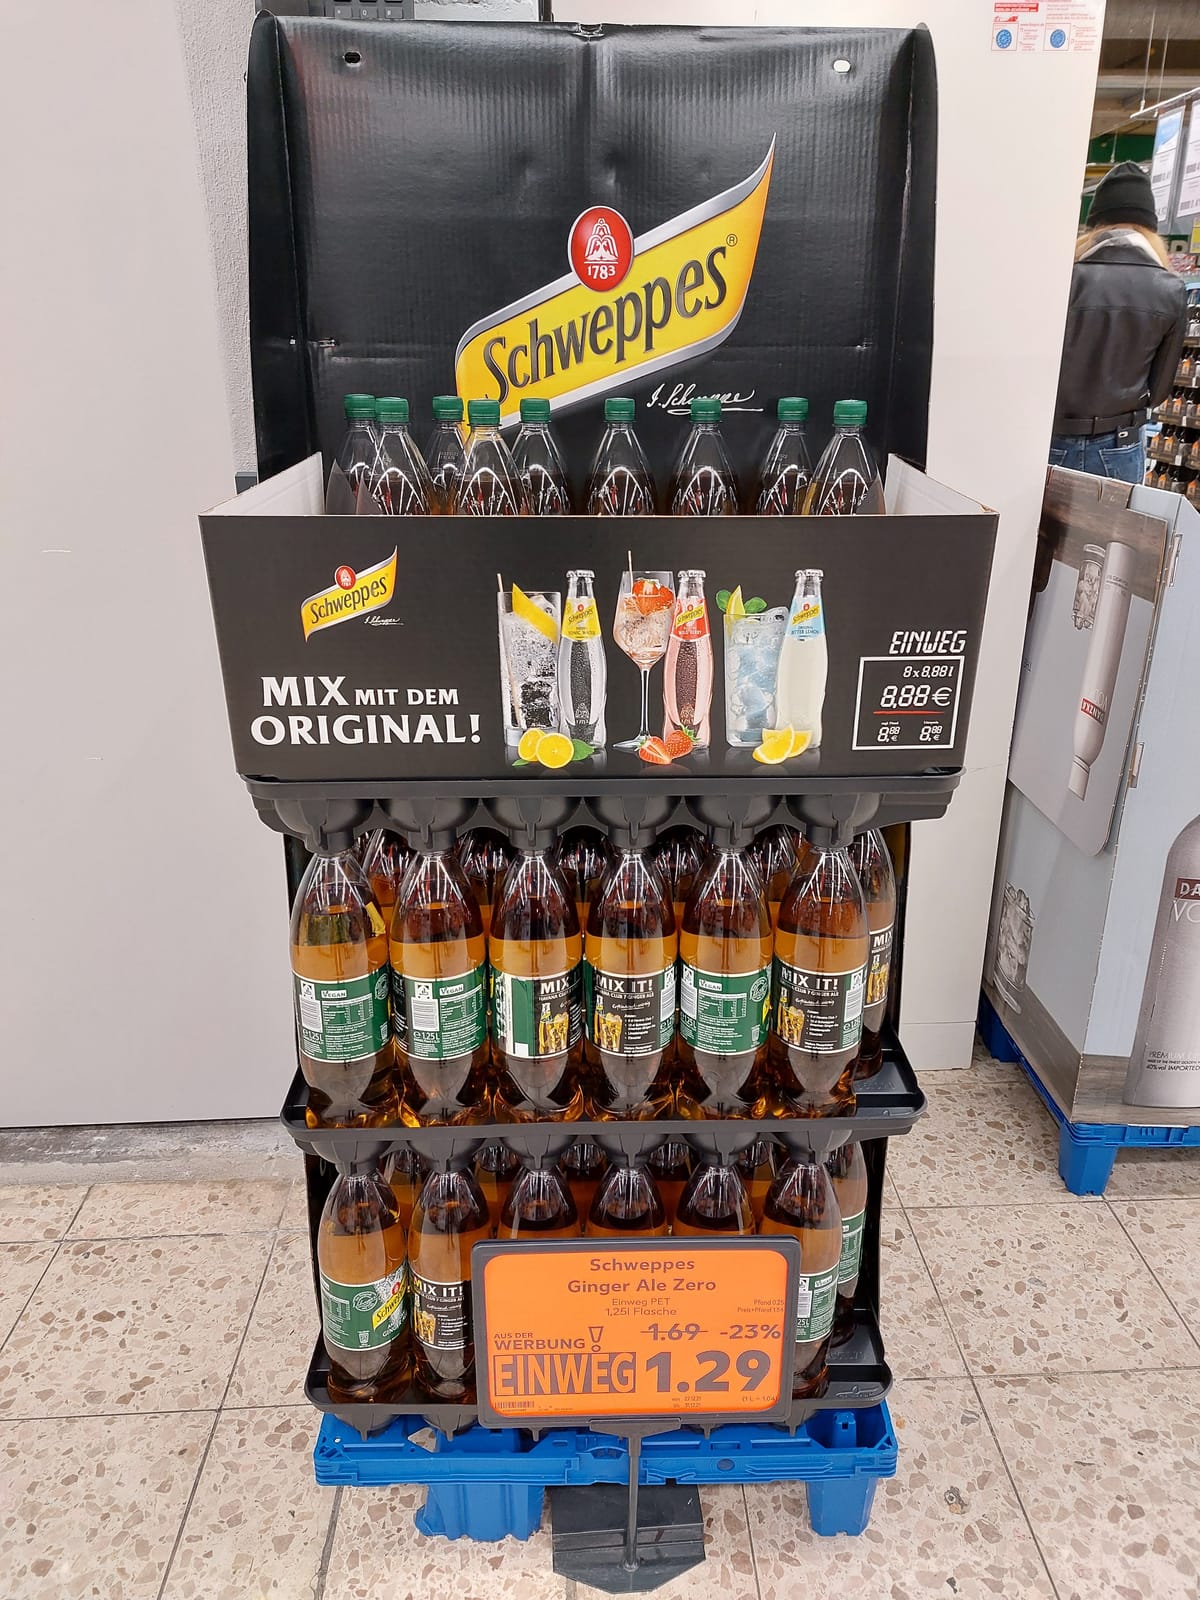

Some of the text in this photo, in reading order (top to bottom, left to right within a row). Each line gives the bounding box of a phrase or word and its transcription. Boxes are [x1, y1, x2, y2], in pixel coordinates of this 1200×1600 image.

[587, 264, 616, 280] 1783
[483, 246, 727, 403] Schweppes
[310, 576, 387, 624] Schweppes
[888, 630, 967, 655] EINWEG
[260, 675, 459, 707] MIX MIT DEM
[250, 713, 481, 746] ORIGINAL!
[540, 977, 569, 995] MIX
[596, 975, 625, 993] MIX
[632, 980, 653, 993] IT!
[781, 966, 839, 990] MIX IT!
[590, 1258, 696, 1274] Schweppes
[442, 1286, 463, 1297] IT!
[567, 1277, 717, 1296] Ginger Ale Zero
[611, 1297, 671, 1307] Einweg PET
[633, 1306, 677, 1316] Flasche
[647, 1322, 782, 1341] 1.69 -23%
[494, 1338, 585, 1350] WERBUNG
[493, 1349, 772, 1396] EINWEG 1.29
